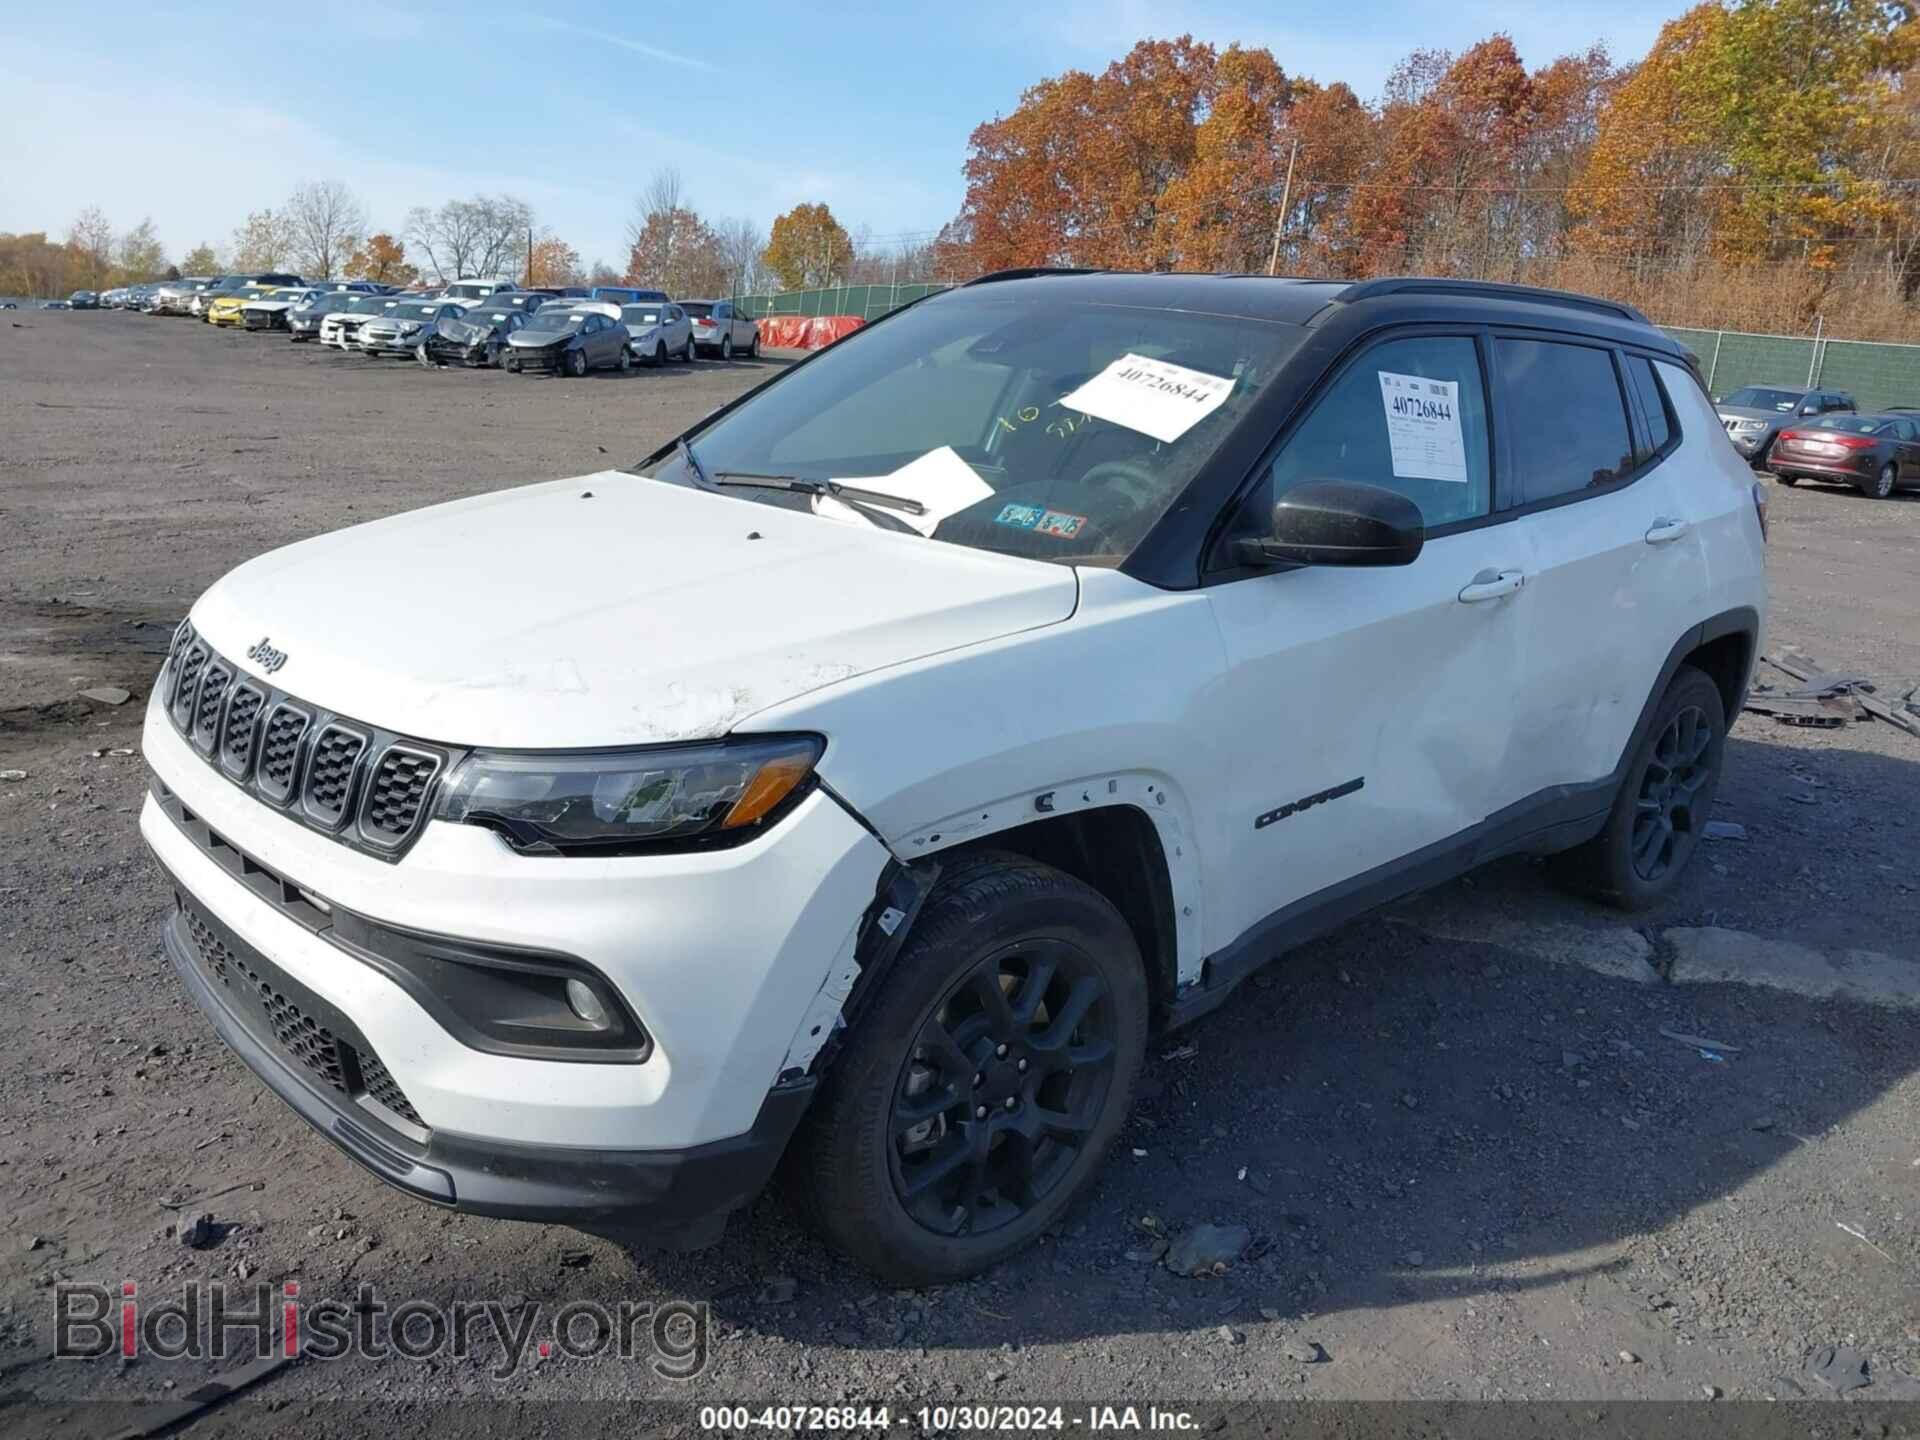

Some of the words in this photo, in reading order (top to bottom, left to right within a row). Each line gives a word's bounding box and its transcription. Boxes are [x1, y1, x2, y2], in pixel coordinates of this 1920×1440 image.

[1117, 366, 1211, 403] 40726844
[1392, 396, 1451, 421] 40726844
[247, 636, 288, 674] Jeep
